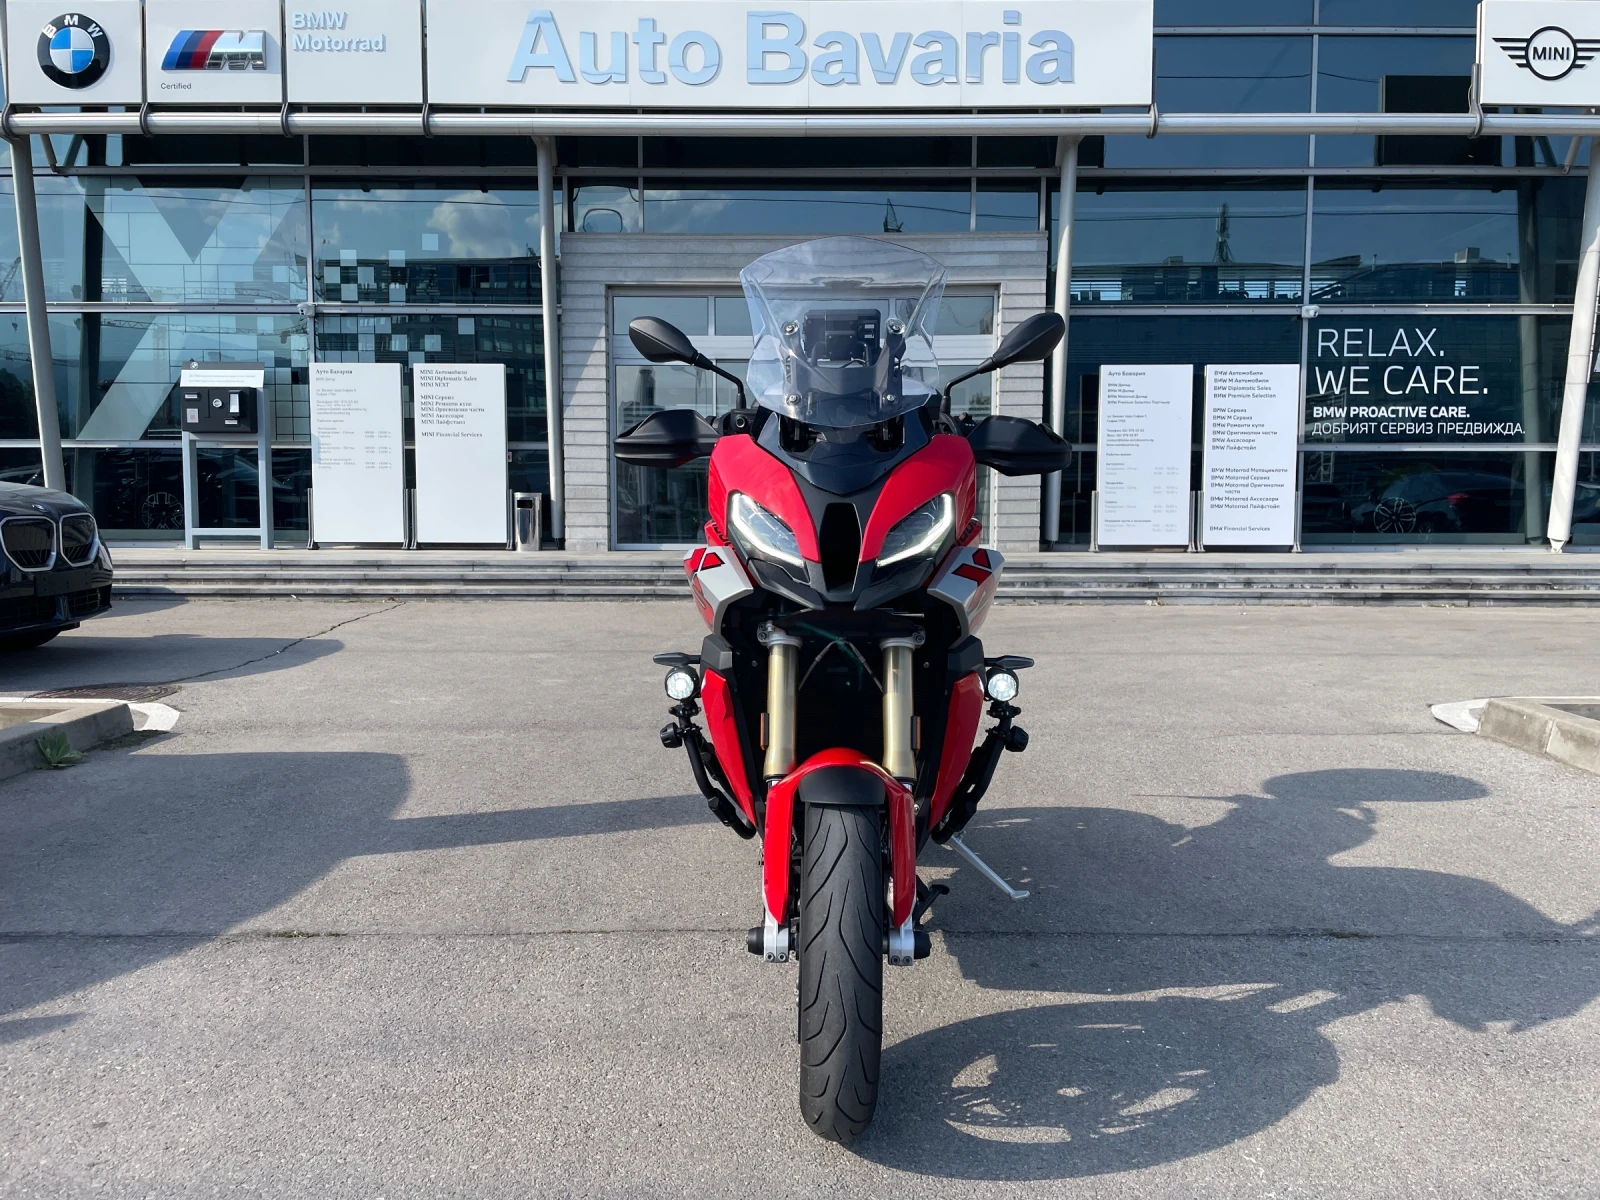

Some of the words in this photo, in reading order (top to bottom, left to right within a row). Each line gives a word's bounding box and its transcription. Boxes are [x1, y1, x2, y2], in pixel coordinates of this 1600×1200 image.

[42, 15, 103, 38] BMW
[291, 11, 347, 30] BMW
[292, 33, 386, 52] Motorrad
[506, 9, 722, 85] Auto
[746, 10, 1075, 85] Bavaria
[1532, 46, 1570, 60] MINI
[160, 82, 192, 90] Certified
[1317, 327, 1445, 357] RELAX.
[1315, 365, 1370, 395] WE
[1383, 365, 1488, 395] CARE.
[1313, 406, 1347, 418] BMW
[1350, 406, 1427, 418] PROACTIVE
[1429, 406, 1470, 418] CARE.
[1312, 422, 1378, 436] ДОБРИЯТ
[1380, 422, 1433, 435] СЕРВИЗ
[1437, 422, 1526, 436] ПРЕДВИЖДА.
